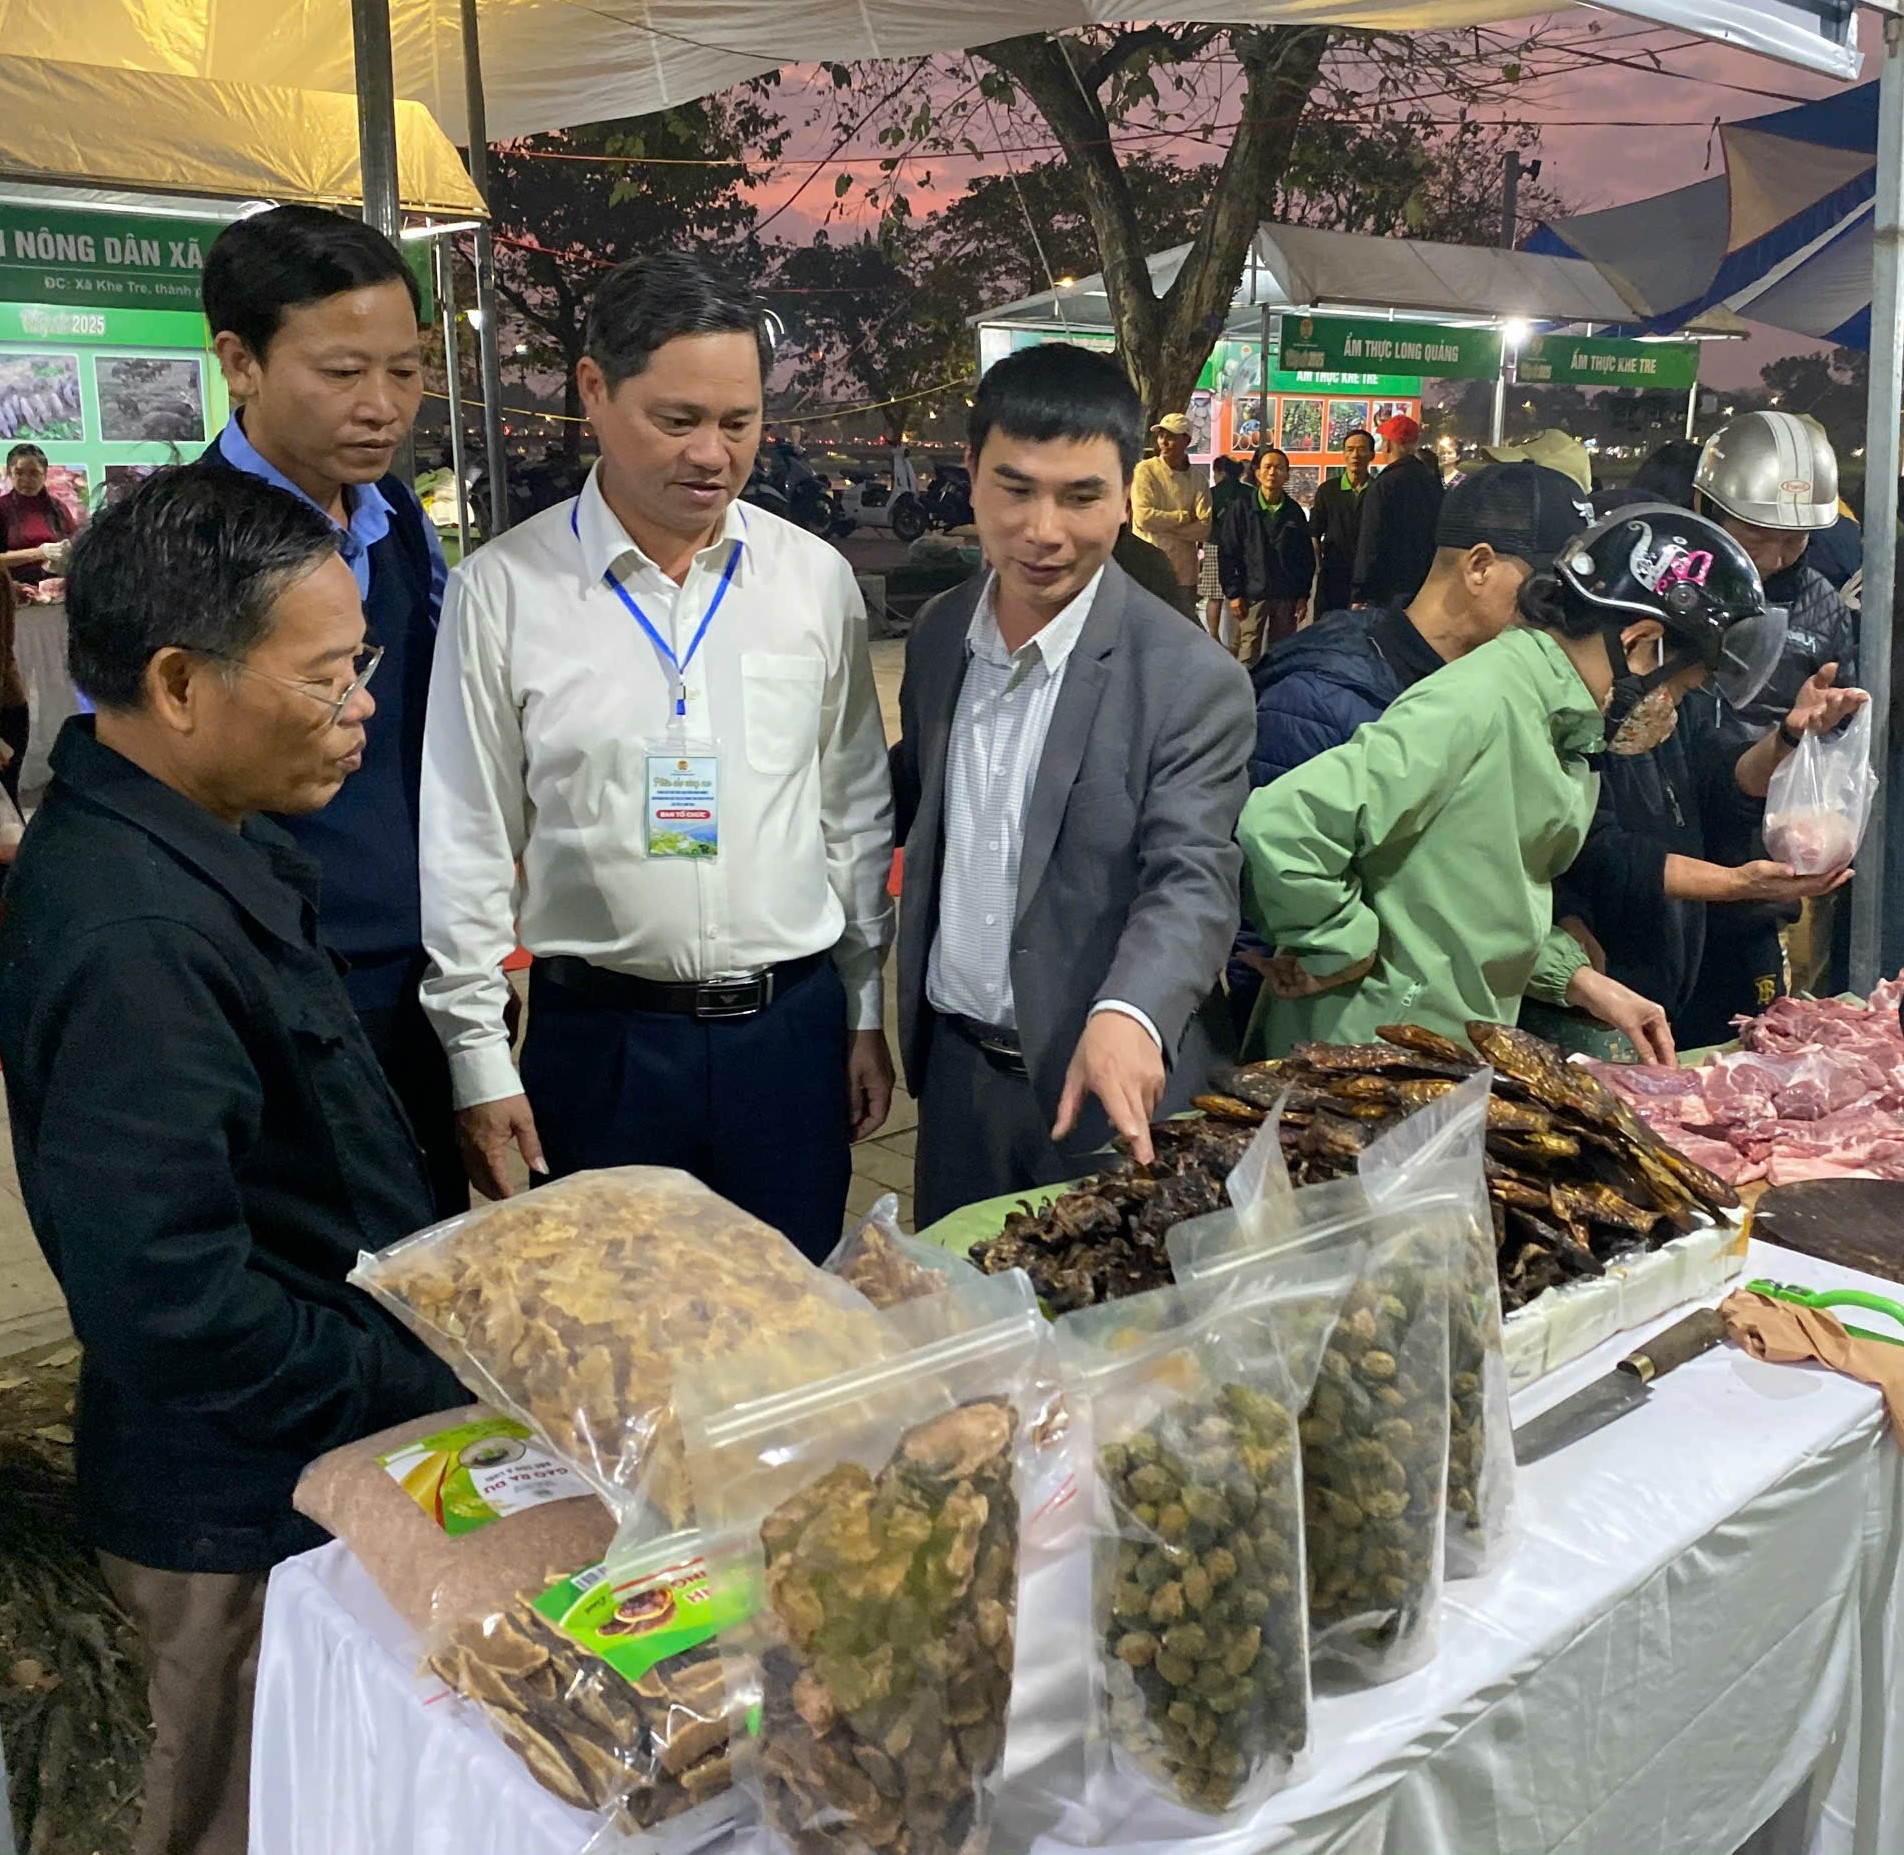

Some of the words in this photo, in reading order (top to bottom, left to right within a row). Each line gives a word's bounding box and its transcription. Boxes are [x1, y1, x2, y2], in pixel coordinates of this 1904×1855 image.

[14, 227, 96, 263] NÔNG
[104, 233, 161, 266] DÂN
[169, 237, 203, 269] XÃ
[44, 277, 71, 290] ĐC:
[97, 280, 123, 292] Khe
[72, 314, 106, 335] 2025
[1365, 339, 1392, 362] THỰC
[1395, 342, 1422, 360] LONG
[1591, 353, 1616, 375] THỰC
[1618, 357, 1637, 373] KHE
[1639, 358, 1656, 374] TRE
